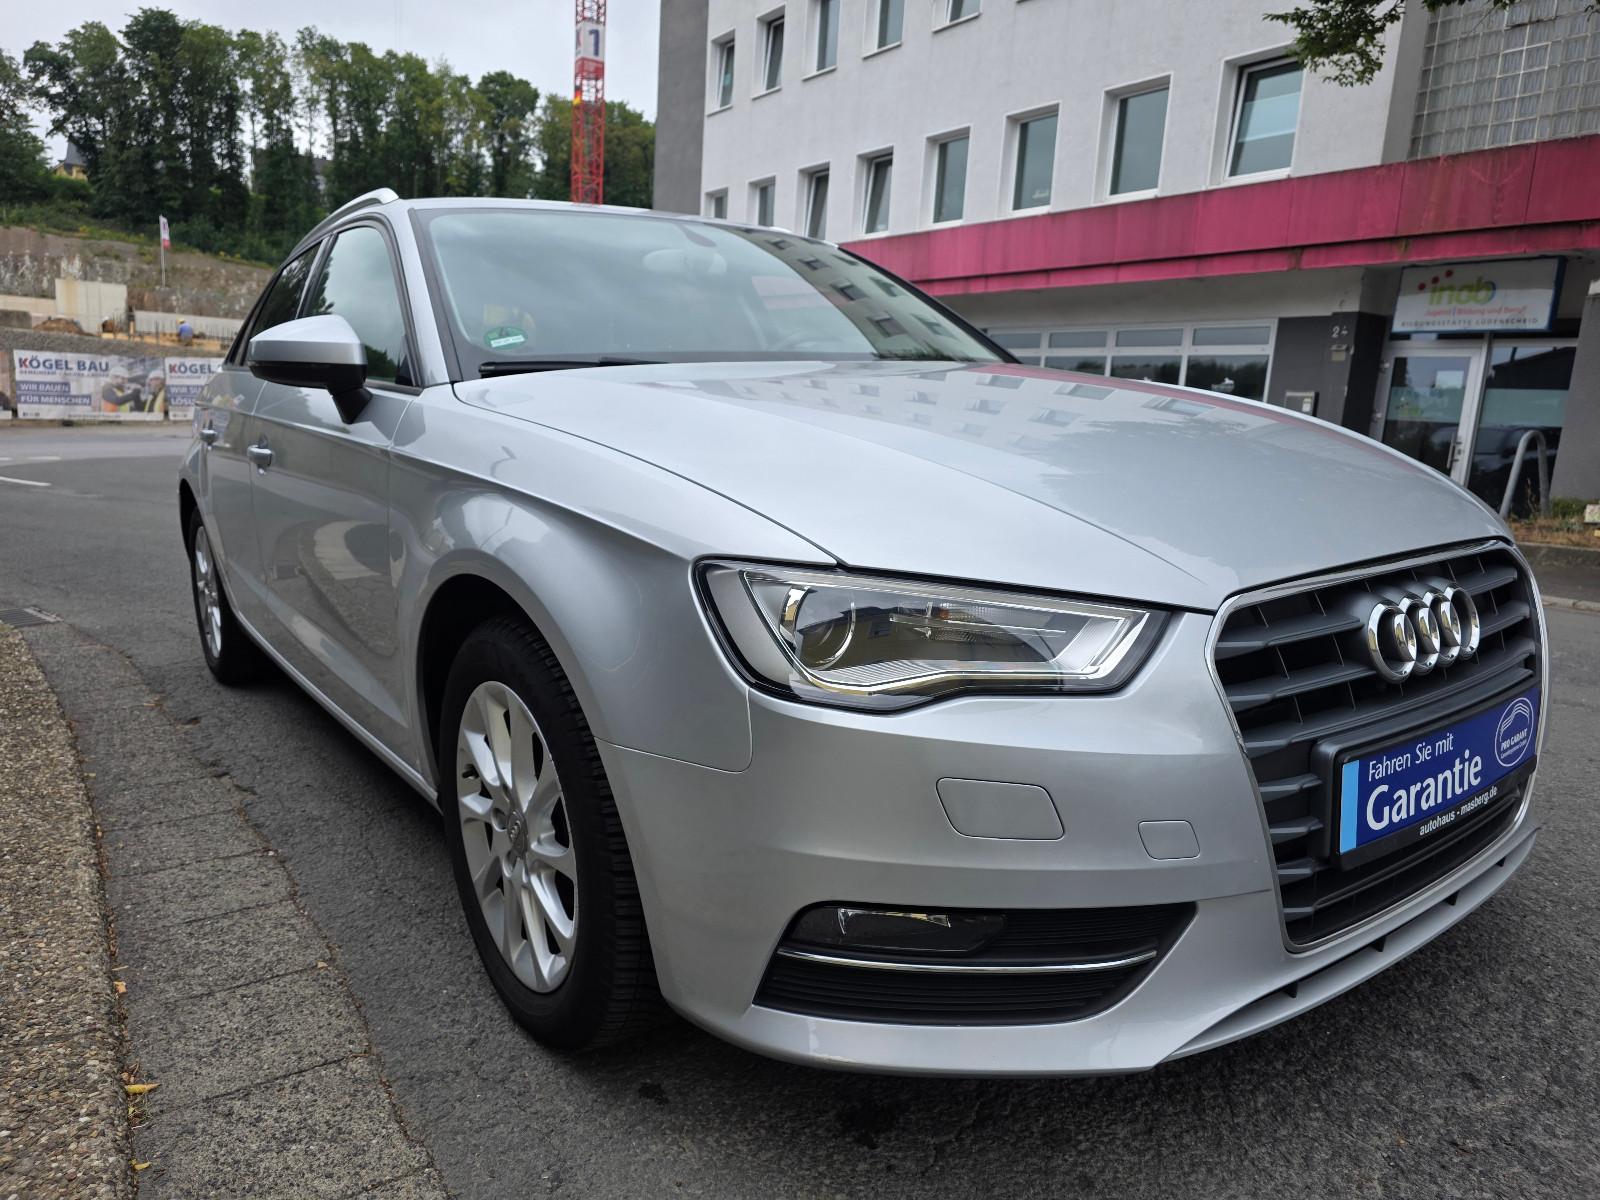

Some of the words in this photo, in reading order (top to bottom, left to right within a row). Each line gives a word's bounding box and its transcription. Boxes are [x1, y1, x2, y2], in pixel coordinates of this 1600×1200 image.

[588, 29, 600, 56] 1
[18, 354, 74, 371] KÖGEL
[77, 359, 110, 372] BAU
[20, 383, 37, 391] WIR
[39, 383, 70, 392] BAUEN
[20, 394, 39, 403] FÜR
[40, 395, 90, 405] MENSCHEN
[1500, 739, 1511, 751] PRO
[1510, 728, 1528, 745] GARANT
[1368, 752, 1411, 782] Fahren
[1415, 743, 1432, 764] Sie
[1435, 732, 1454, 757] mit
[1366, 749, 1482, 831] Garantie
[1419, 810, 1456, 836] autohaus
[1460, 785, 1498, 815] masberg.de
